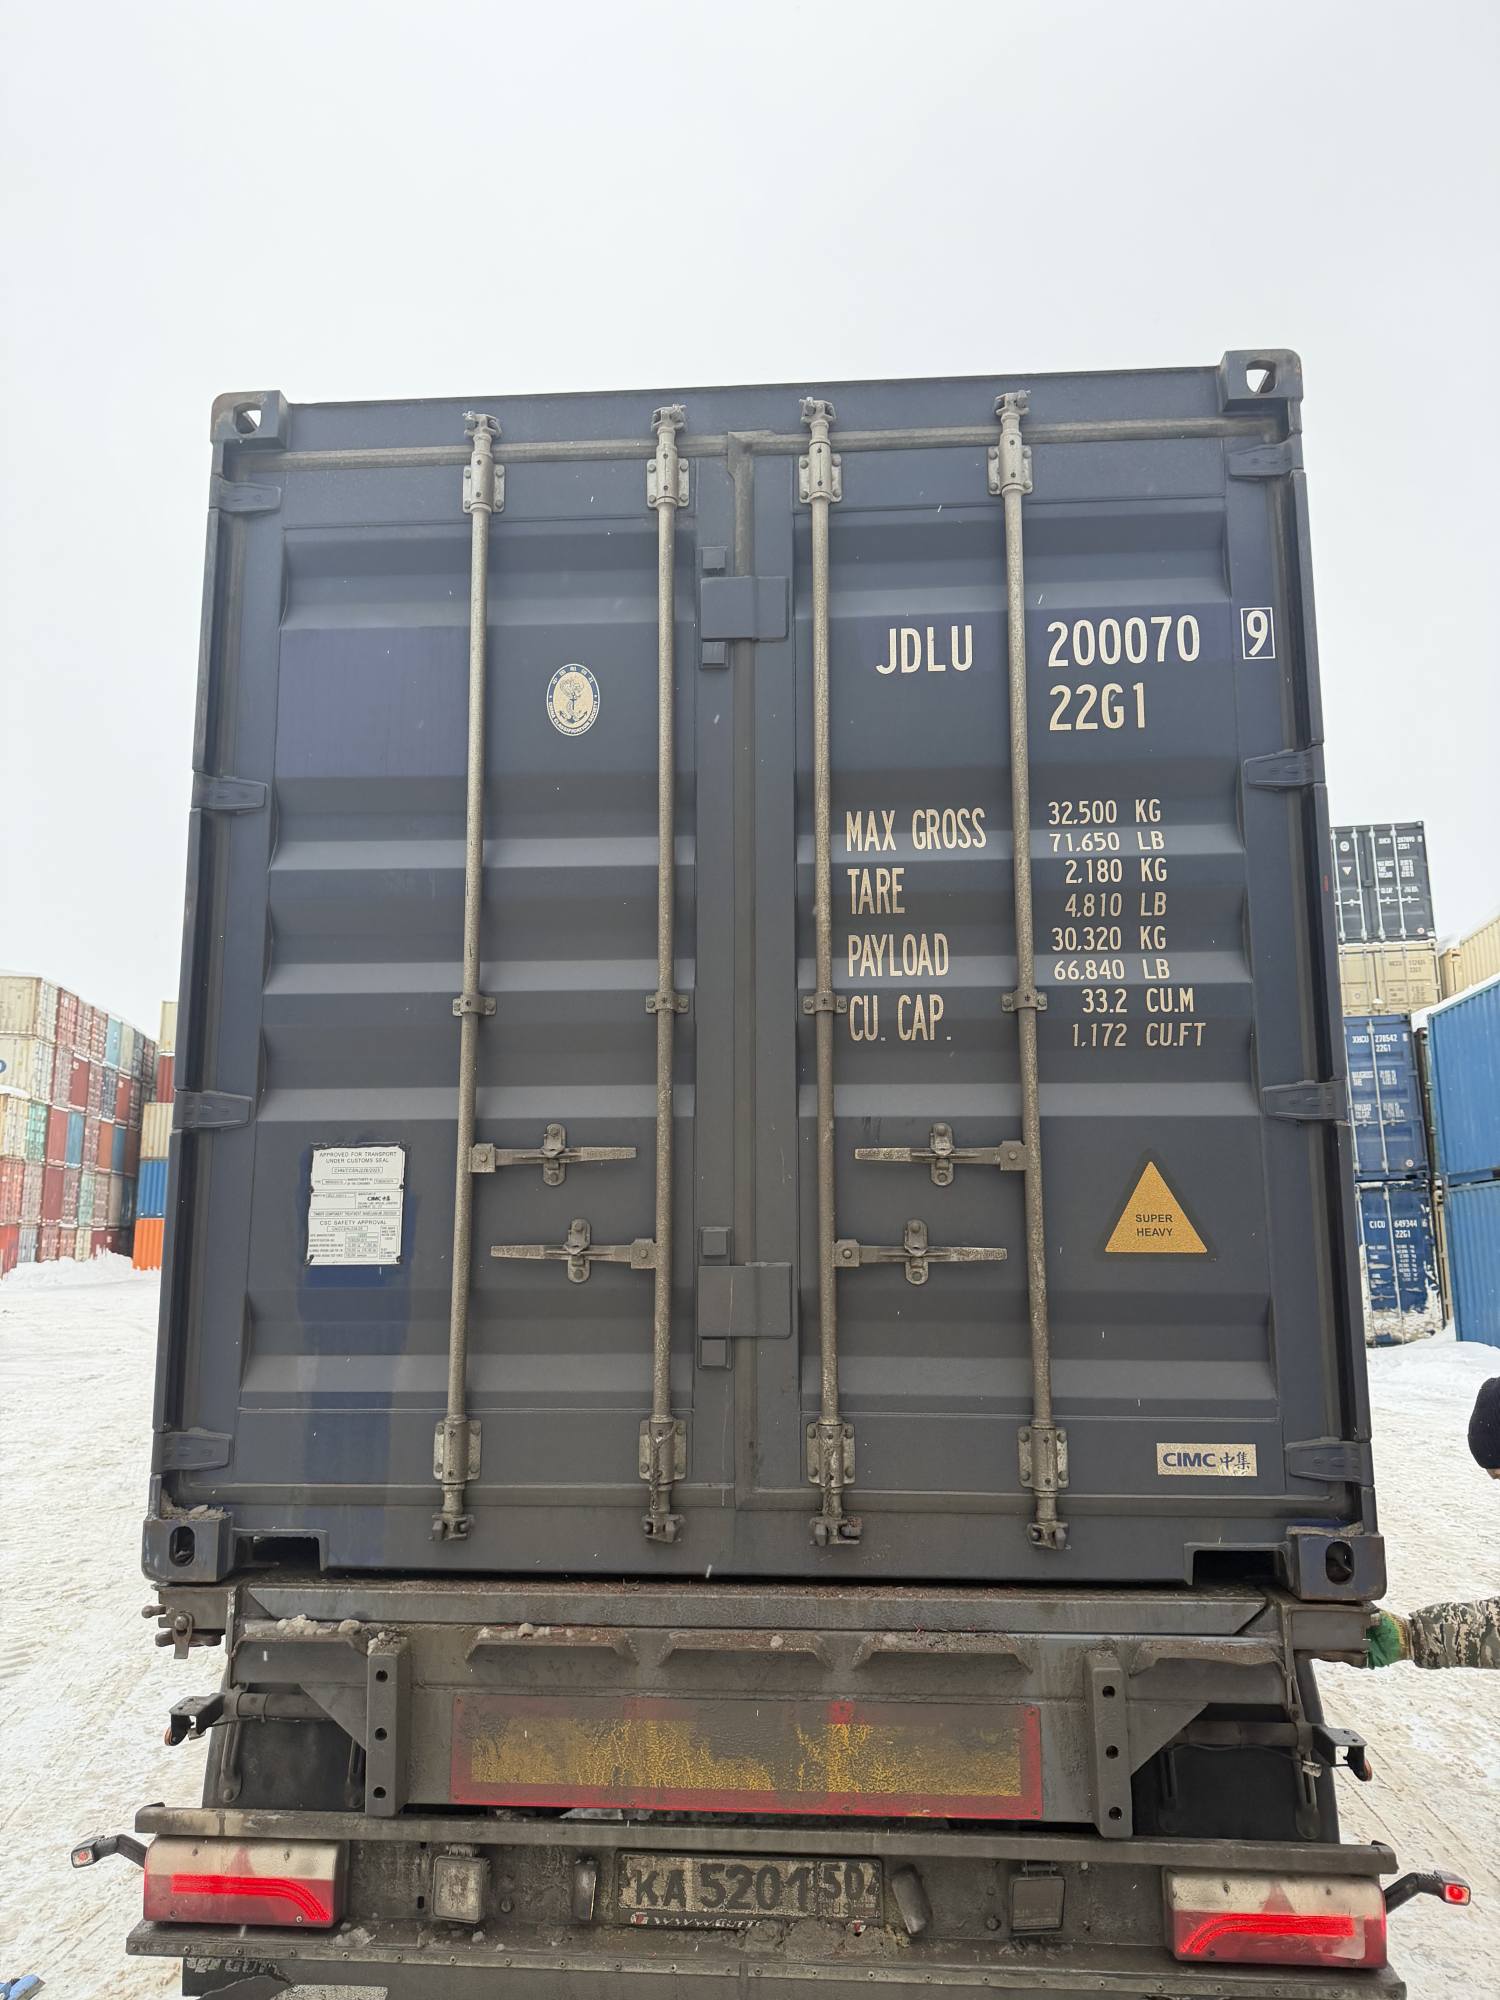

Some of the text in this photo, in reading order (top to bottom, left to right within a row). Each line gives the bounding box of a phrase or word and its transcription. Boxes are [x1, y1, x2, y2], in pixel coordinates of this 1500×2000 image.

[876, 613, 1270, 674] JDLU 200070 9
[1048, 682, 1146, 731] 22G1
[846, 799, 1162, 852] MAX GROSS 32,500 KG
[1049, 830, 1165, 853] 71,650 LB
[847, 857, 1168, 915] TARE 2,180 KG
[1065, 891, 1167, 918] 4,810 LB
[847, 925, 1166, 978] PAYLOAD 30,320 KG
[1054, 958, 1170, 980] 66,840 LB
[848, 987, 1194, 1041] CU. CAP. 33.2 CU.M
[1072, 1022, 1207, 1048] 1,172 CU.FT
[1135, 1214, 1174, 1223] SUPER
[1136, 1227, 1173, 1237] HEAVY
[1162, 1452, 1217, 1468] CIMC
